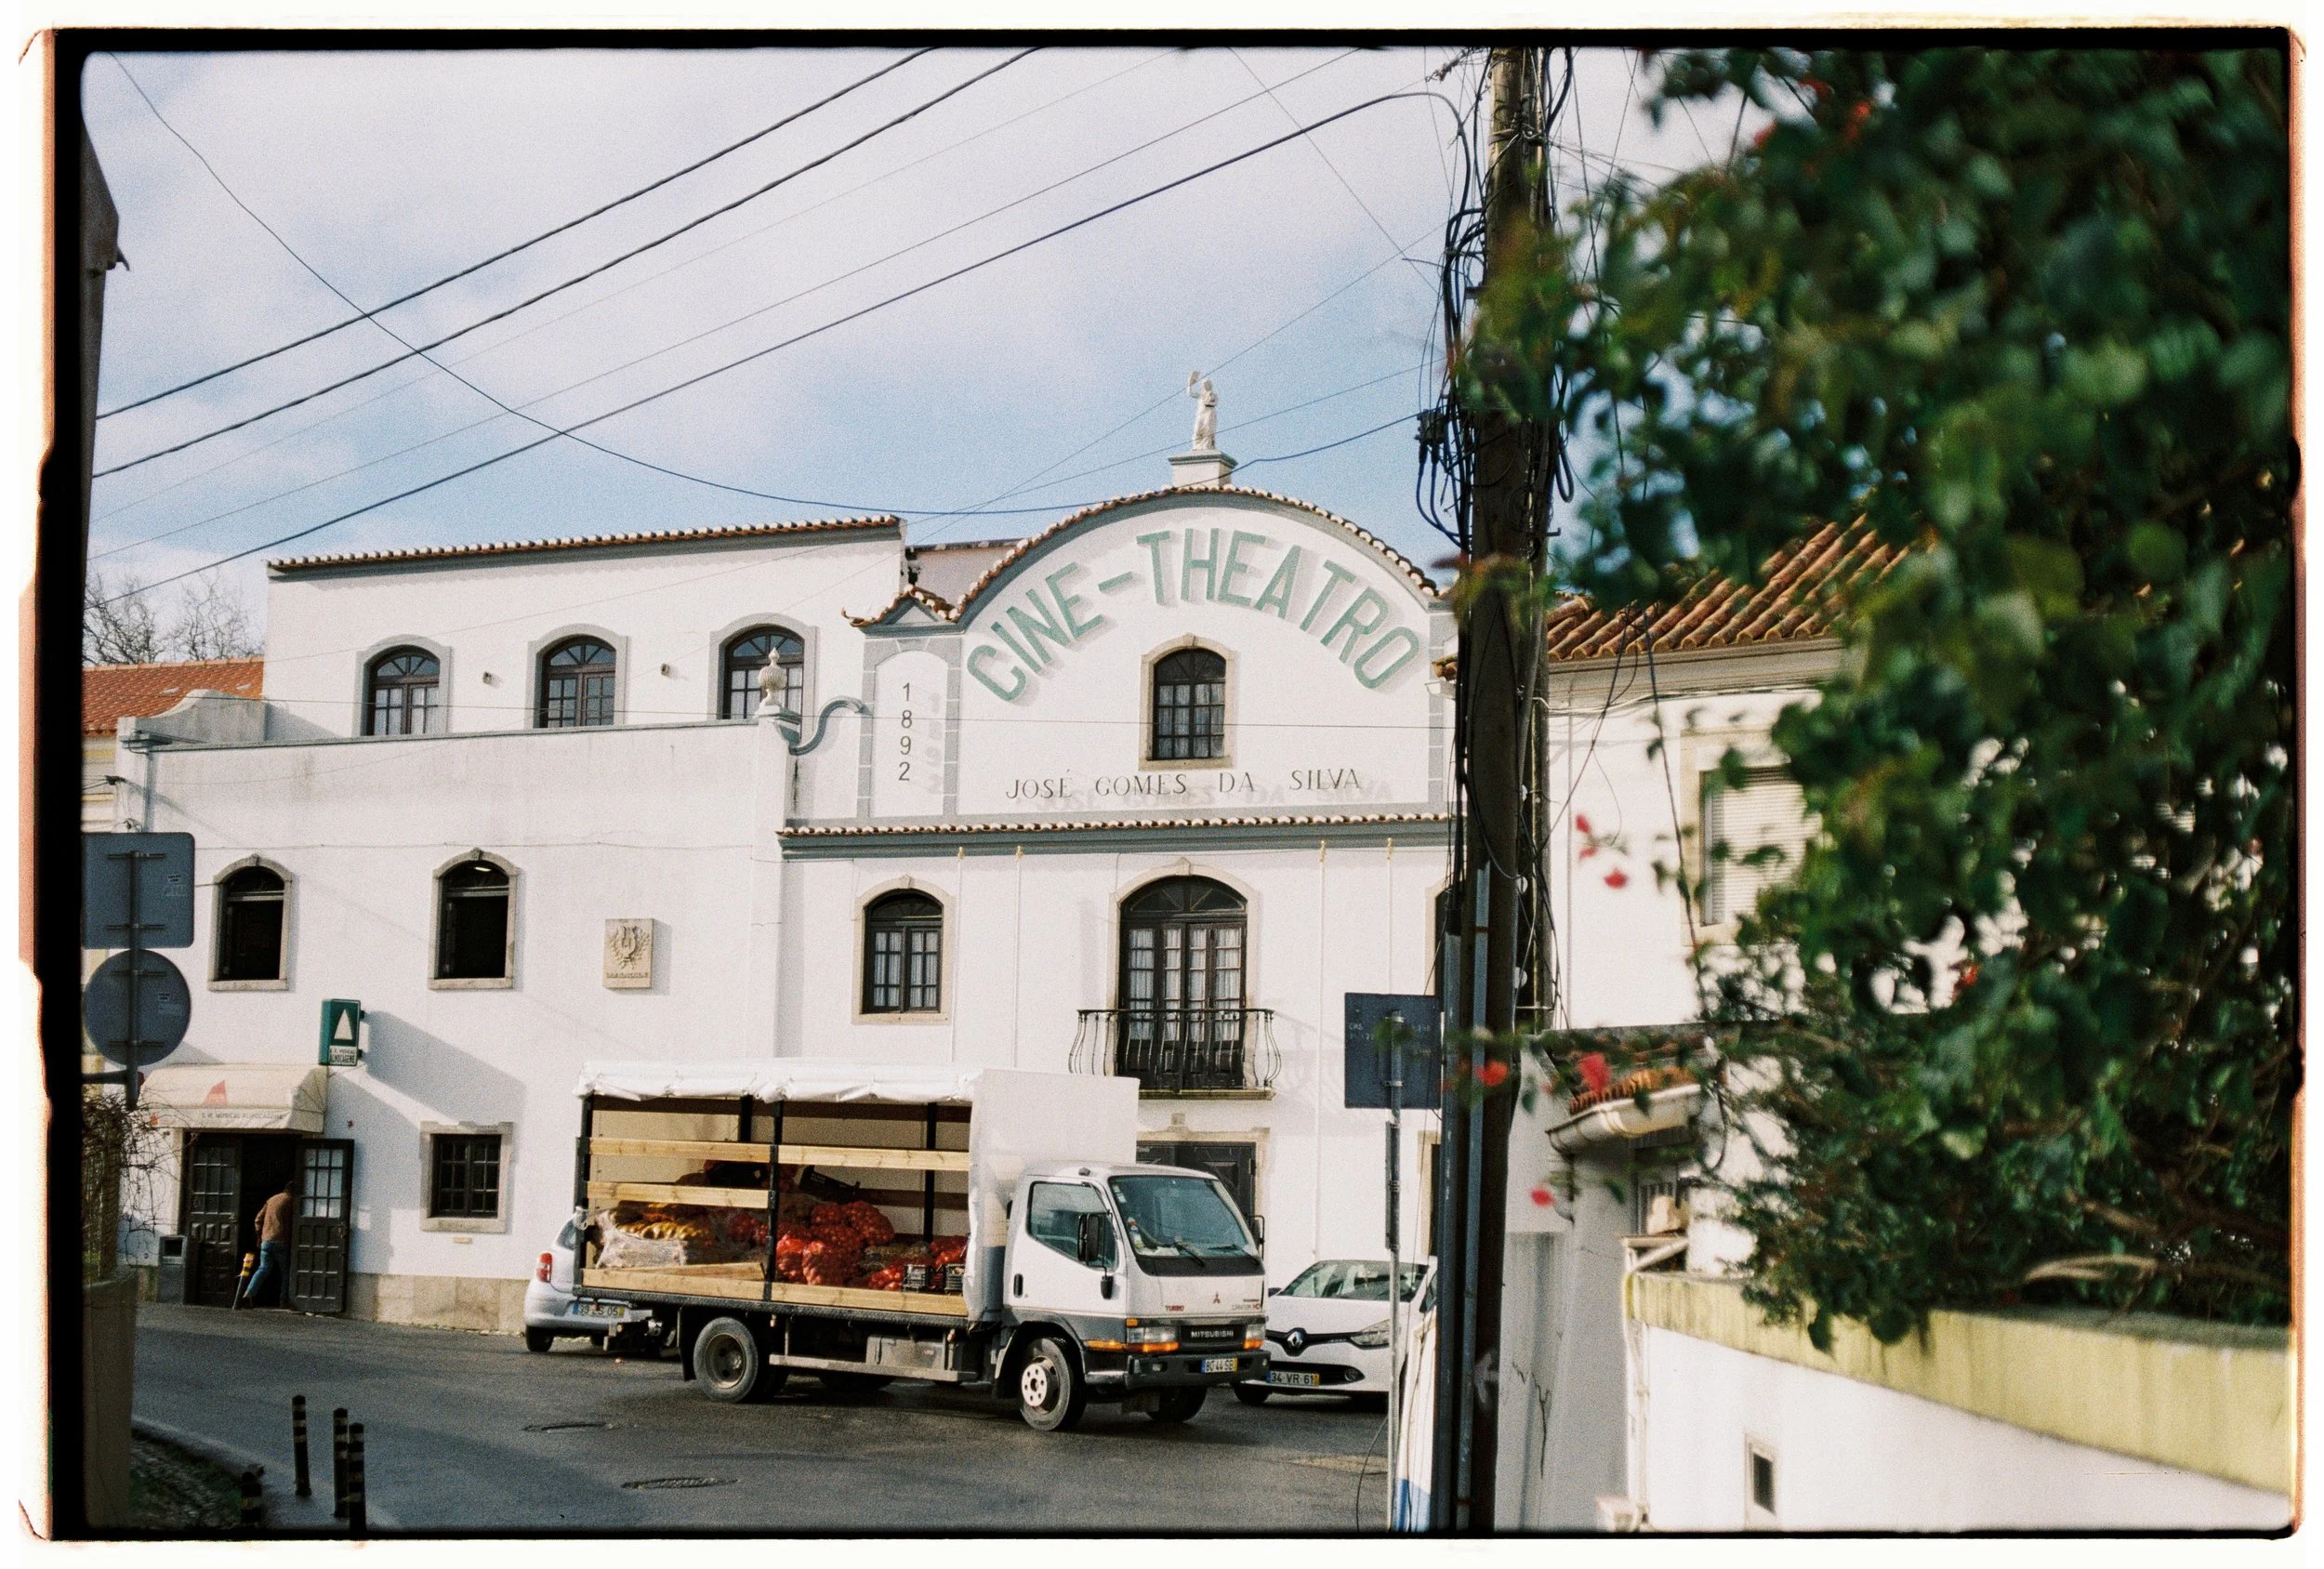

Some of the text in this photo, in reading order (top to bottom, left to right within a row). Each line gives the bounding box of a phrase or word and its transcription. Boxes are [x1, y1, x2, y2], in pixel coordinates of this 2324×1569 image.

[967, 527, 1420, 703] CINE-THEATRO
[898, 681, 913, 782] 1892
[1006, 768, 1362, 800] JOSÉ GOMES DA SILVA
[1191, 1330, 1235, 1338] MITSUBISHI
